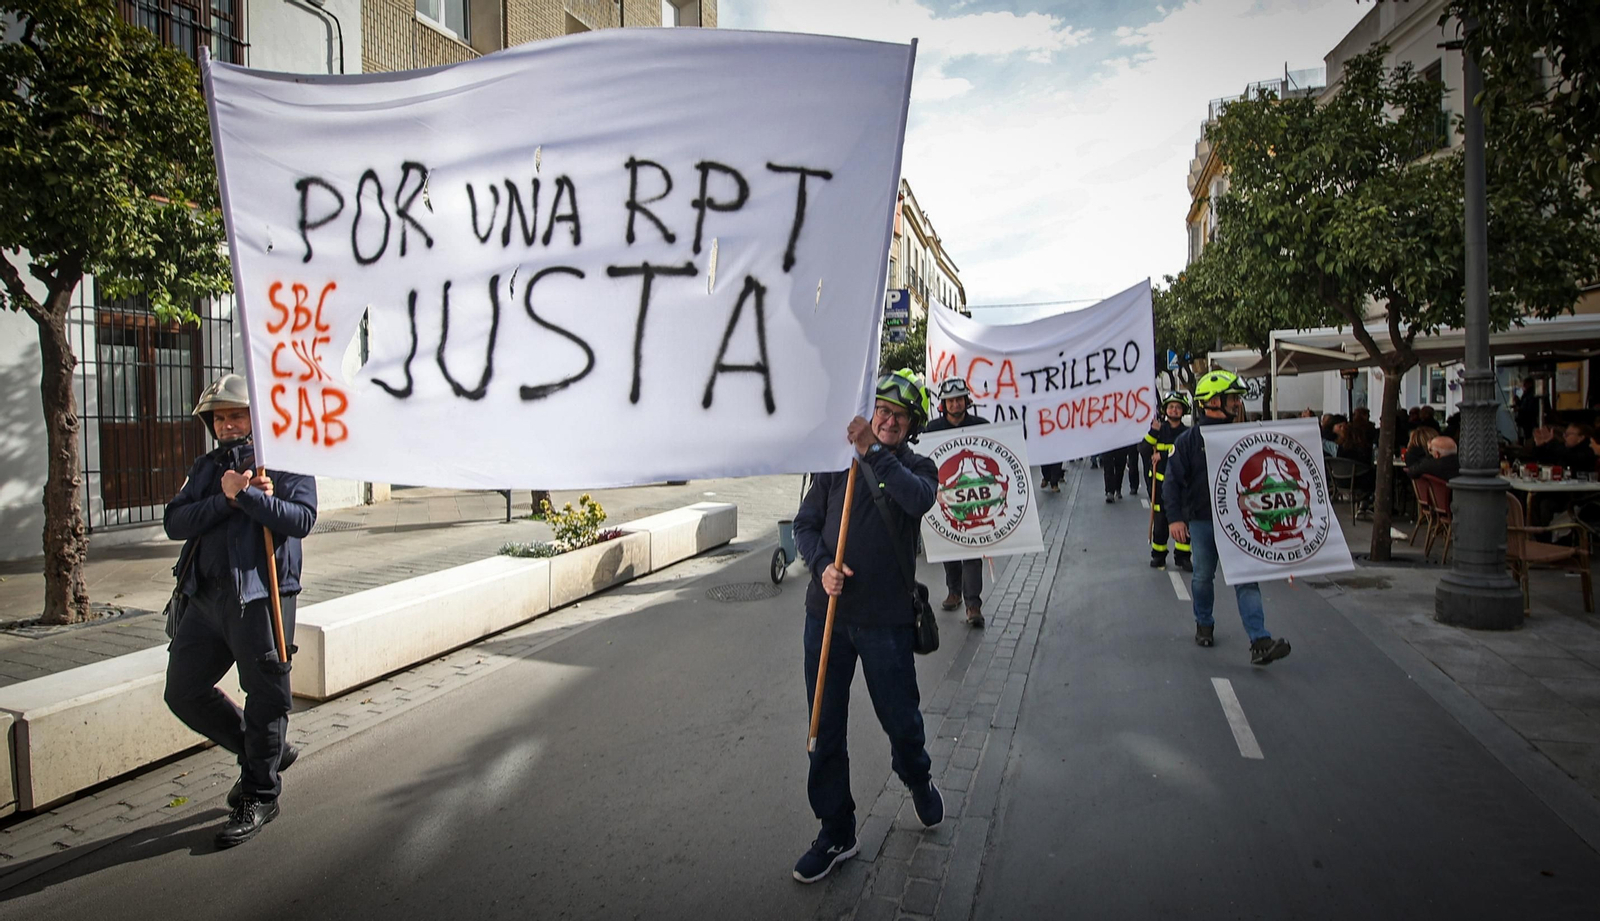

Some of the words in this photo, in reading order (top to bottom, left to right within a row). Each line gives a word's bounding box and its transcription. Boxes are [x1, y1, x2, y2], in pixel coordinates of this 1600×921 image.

[296, 161, 434, 265] POR
[466, 175, 581, 247] UNA
[625, 156, 833, 273] RPT
[266, 281, 337, 334] SBC
[886, 291, 901, 309] P
[371, 261, 775, 414] JUSTA
[271, 384, 348, 447] SAB
[1038, 387, 1151, 436] BOMBEROS
[934, 437, 979, 459] ANDALUZ
[981, 439, 995, 450] DE
[995, 445, 1026, 495] BOMBEROS
[1217, 454, 1237, 515] SINDICATO
[1236, 433, 1279, 457] ANDALUZ
[1281, 436, 1294, 450] DE
[1295, 445, 1325, 505] BOMBEROS
[955, 486, 991, 503] SAB
[1261, 492, 1296, 510] SAB
[928, 514, 977, 545] PROVINCIA
[979, 535, 993, 544] DE
[994, 504, 1025, 539] SEVILLA
[1226, 523, 1285, 562] PROVINCIA
[1288, 550, 1302, 561] DE
[1304, 515, 1327, 555] SEVILLA
